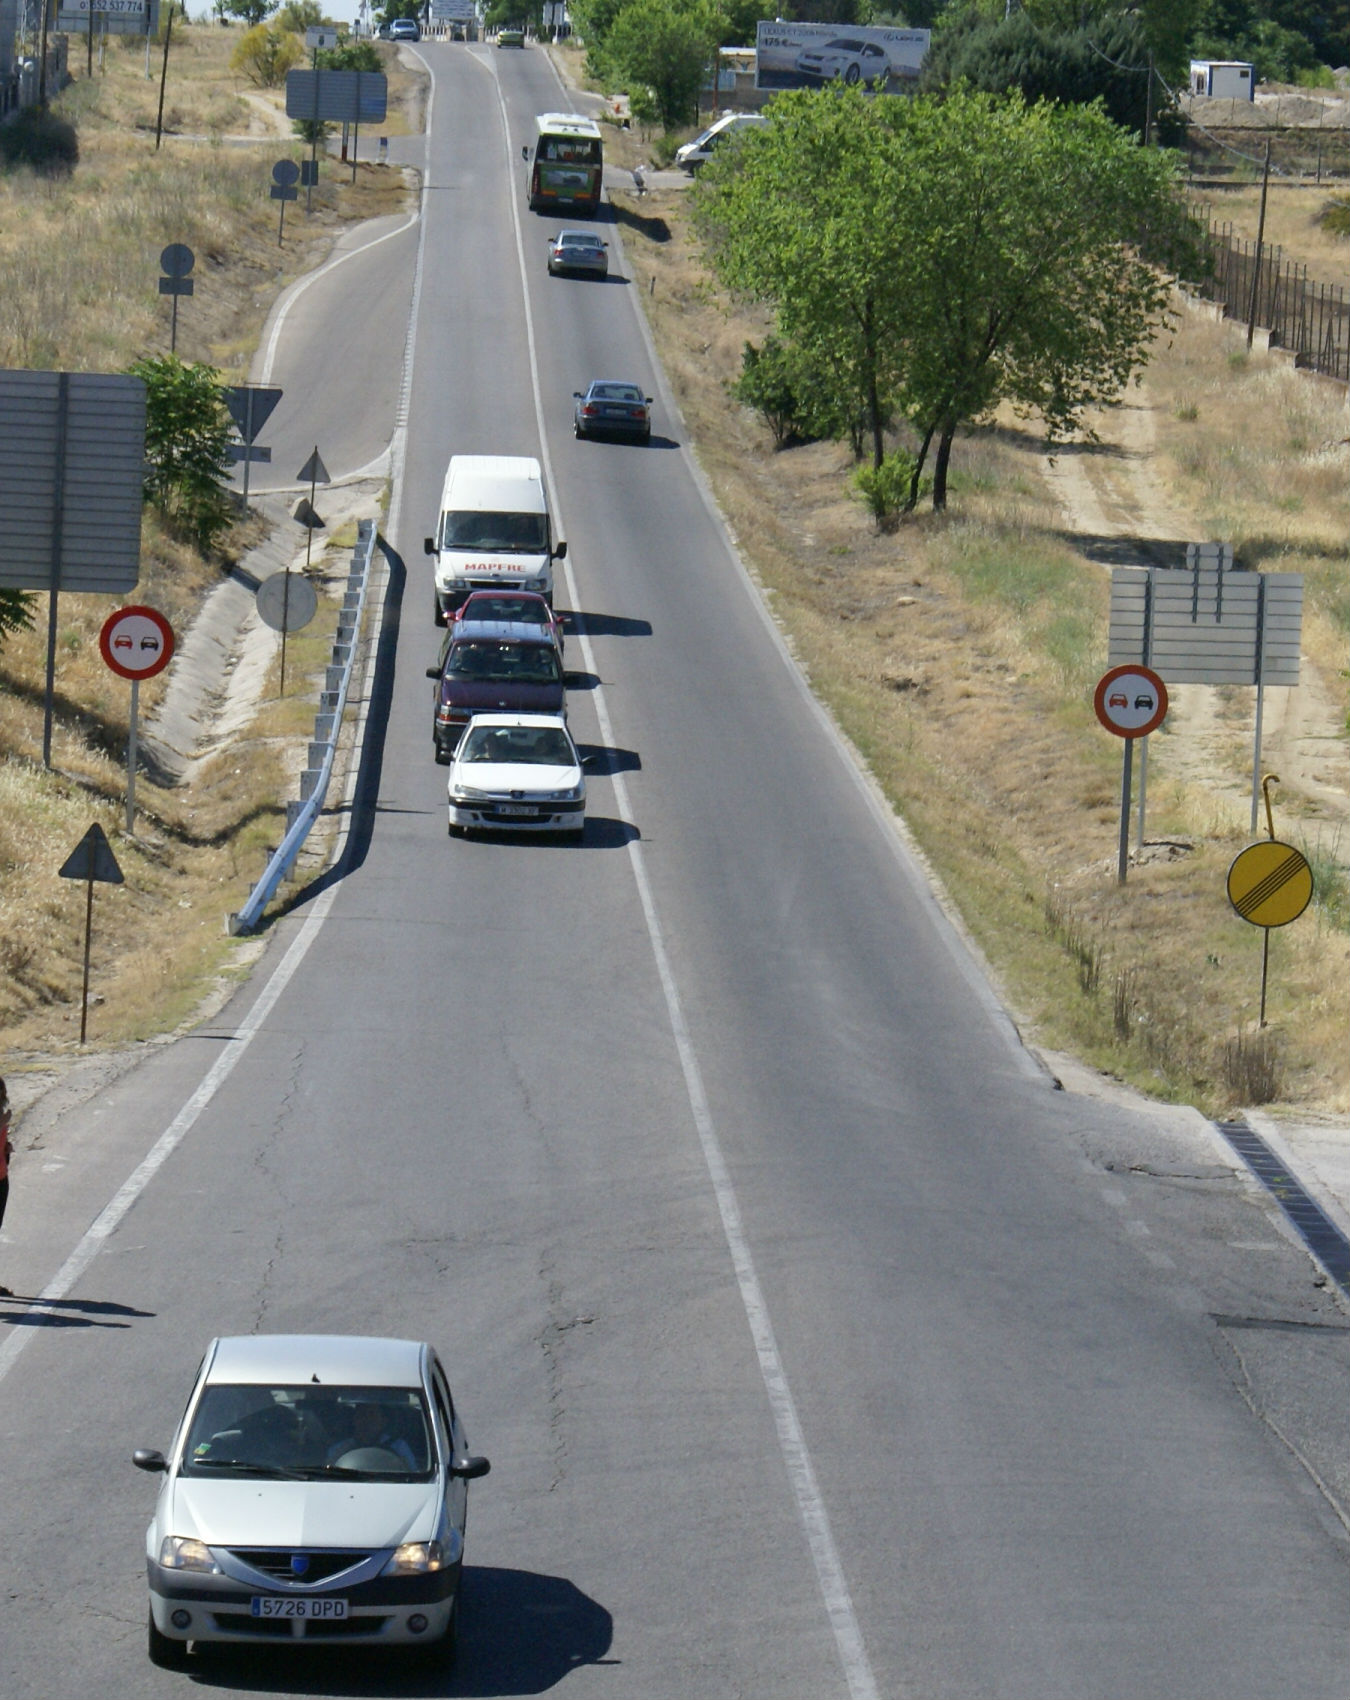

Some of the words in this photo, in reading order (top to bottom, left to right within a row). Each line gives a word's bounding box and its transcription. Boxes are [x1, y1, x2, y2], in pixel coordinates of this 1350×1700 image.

[110, 0, 124, 10] 537
[127, 1, 142, 11] 774
[464, 563, 527, 572] MAPFRE
[263, 1600, 306, 1616] 5726
[312, 1601, 344, 1617] DPD
